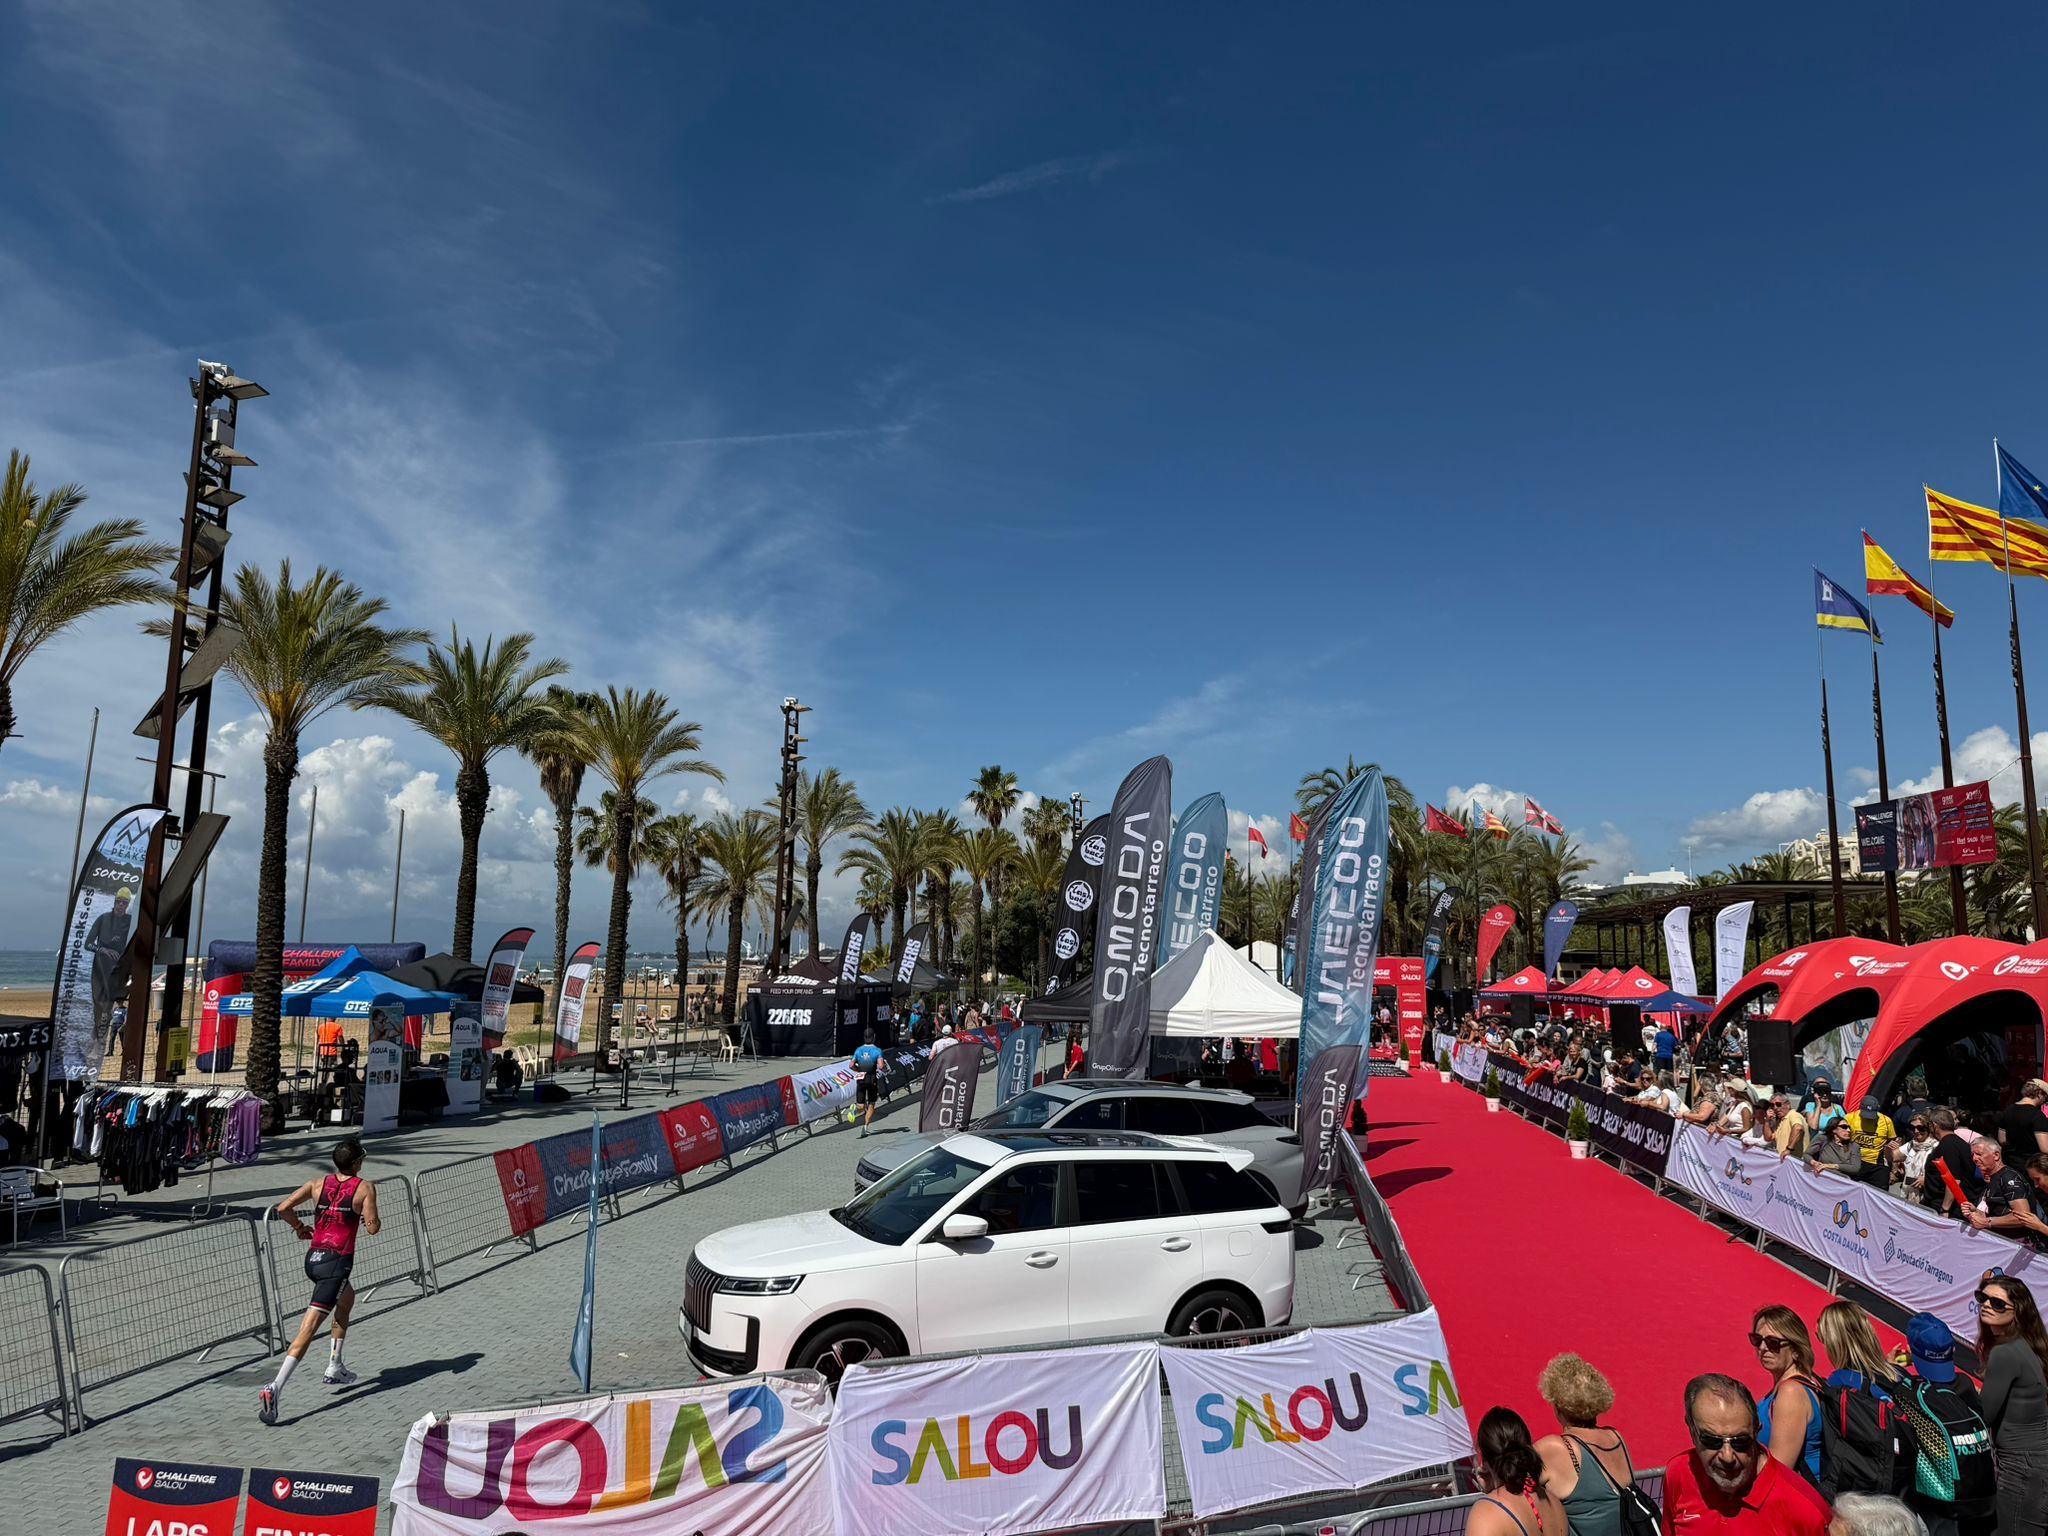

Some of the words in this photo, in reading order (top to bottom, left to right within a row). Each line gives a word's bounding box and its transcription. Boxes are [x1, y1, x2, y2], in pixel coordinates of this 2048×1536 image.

[111, 847, 146, 862] PEAKS
[1084, 837, 1105, 852] Flas
[92, 867, 140, 883] SORTEO
[1170, 832, 1208, 949] ECOO
[1103, 811, 1150, 1002] OMODA
[1132, 839, 1165, 976] Tecnotarraco
[1318, 816, 1366, 1025] JAECOO
[1346, 855, 1382, 990] Tecnotarraco
[282, 959, 326, 967] FAMILY
[283, 950, 346, 958] CHALLENG
[841, 931, 863, 983] 226ERS
[897, 938, 922, 984] 226ERS
[774, 975, 820, 986] 226ERS
[230, 997, 253, 1008] GT2
[767, 1008, 813, 1025] 226ERS
[801, 1077, 833, 1104] SALOU
[939, 1065, 959, 1127] ODA
[955, 1081, 967, 1129] otarraco
[1318, 1068, 1338, 1171] OMODA
[1823, 1228, 1842, 1244] COSTA
[1841, 1237, 1870, 1259] DAURADA
[1897, 1247, 1925, 1271] Diputació
[1924, 1260, 1954, 1284] Tarragona
[1195, 1371, 1370, 1455] SALOU
[871, 1404, 1083, 1485] SALOU
[154, 1480, 187, 1490] SALOU
[156, 1471, 217, 1484] CHALLENGE
[293, 1481, 354, 1495] CHALLENGE
[291, 1490, 325, 1500] SALOU
